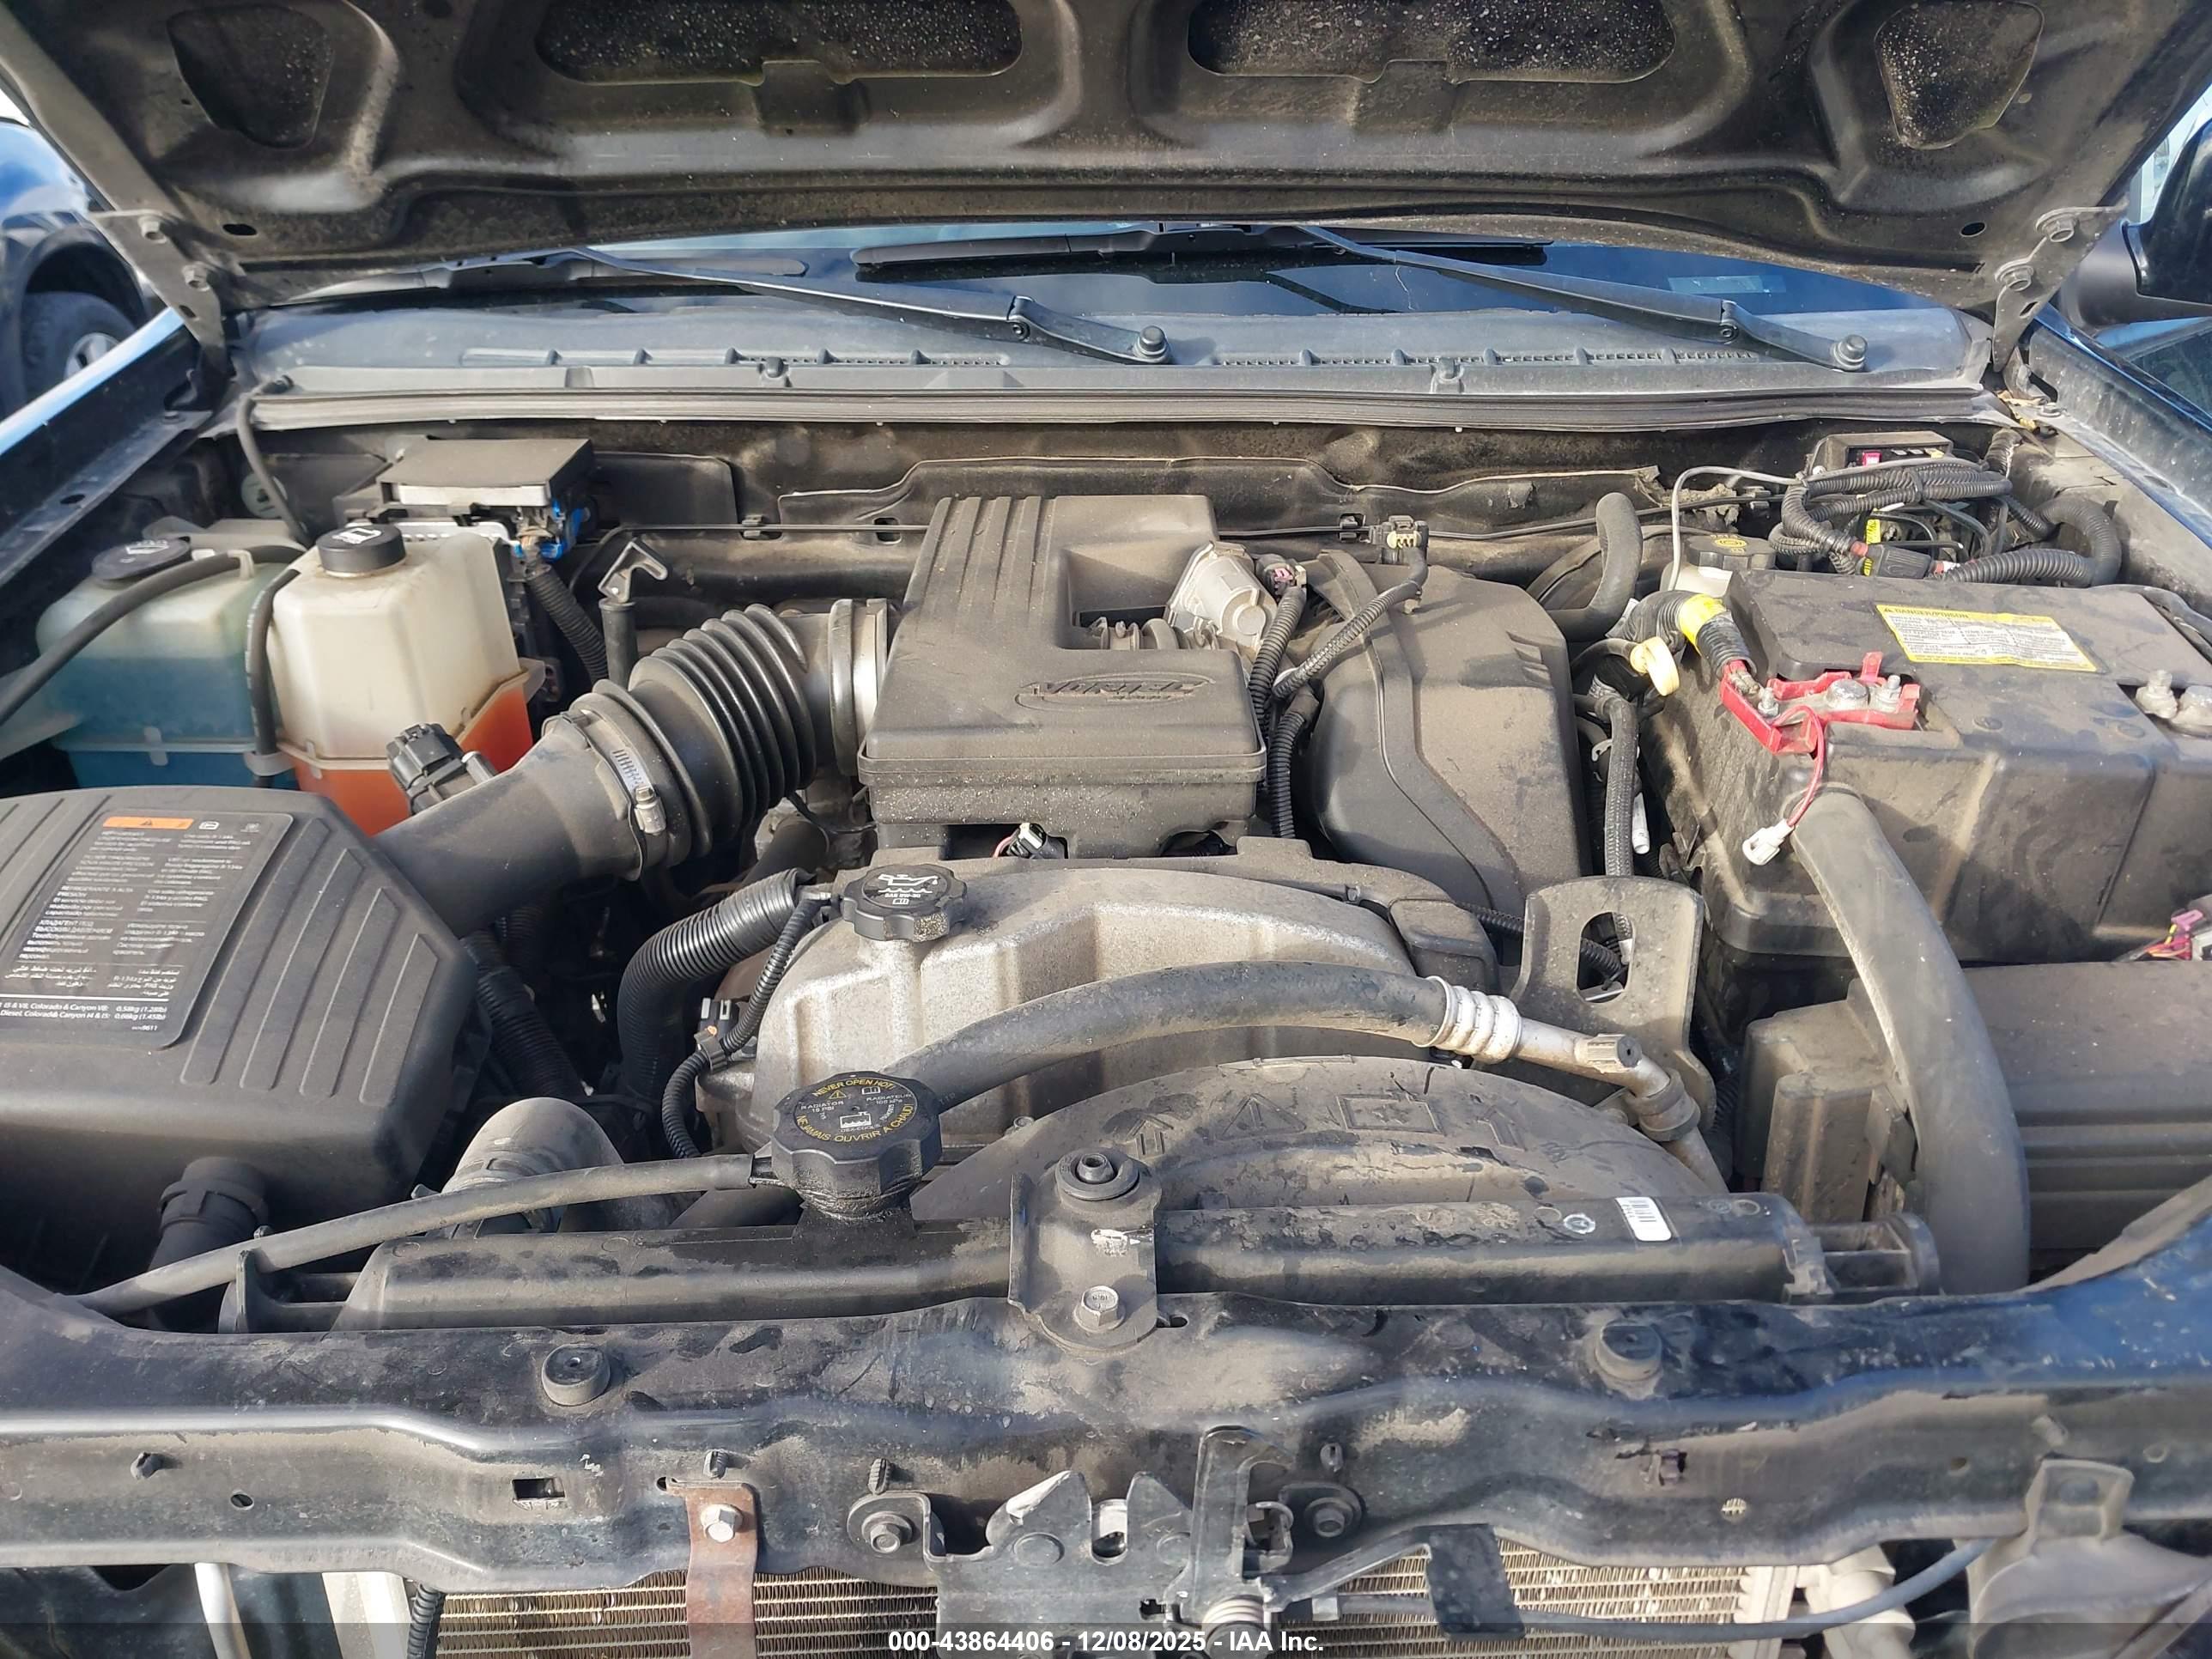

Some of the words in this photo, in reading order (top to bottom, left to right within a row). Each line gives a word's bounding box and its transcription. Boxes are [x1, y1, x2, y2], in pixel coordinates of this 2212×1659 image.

[812, 1081, 845, 1097] NEVER
[866, 1093, 913, 1102] RADIATEUR
[800, 1100, 844, 1110] RADIATOR
[795, 1115, 809, 1127] NE
[805, 1124, 831, 1141] JAMAIS
[834, 1130, 882, 1143] OUVRIR
